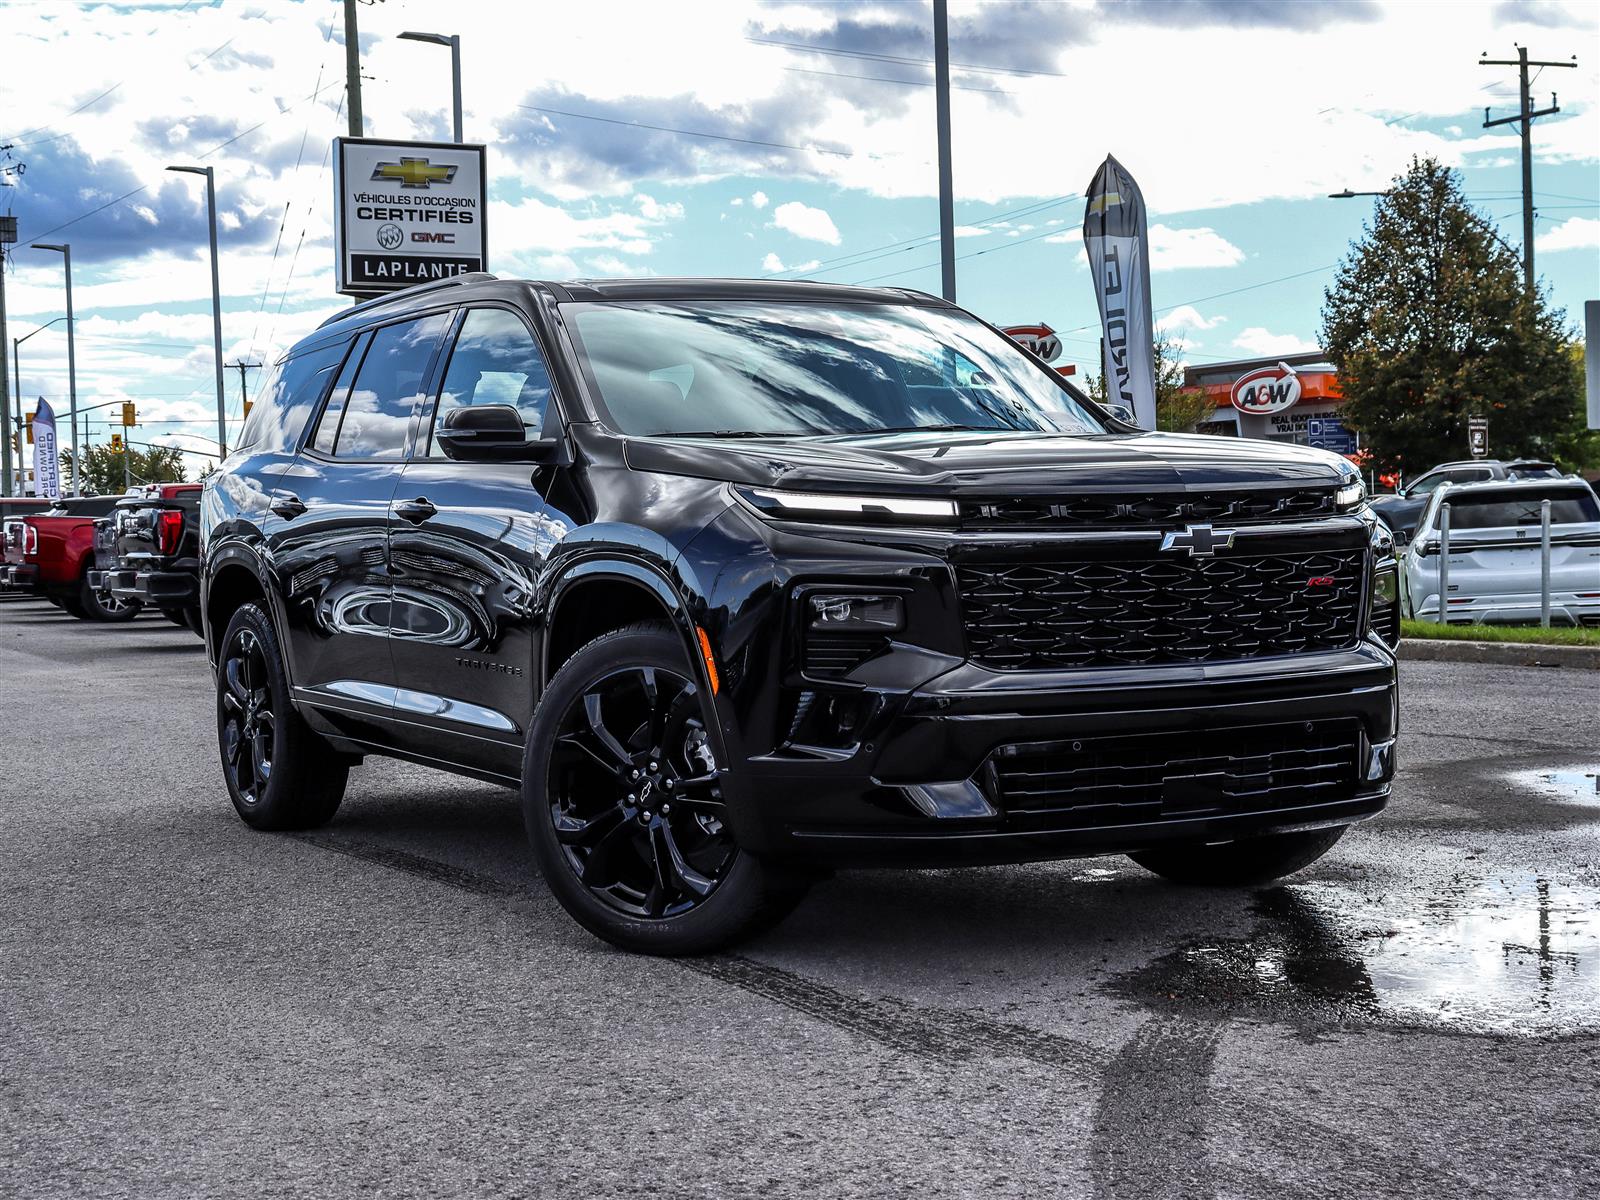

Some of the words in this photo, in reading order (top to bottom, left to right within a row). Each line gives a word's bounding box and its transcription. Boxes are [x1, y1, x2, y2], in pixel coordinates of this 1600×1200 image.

[353, 191, 411, 205] VÉHICULES
[414, 195, 476, 208] D'OCCASION
[356, 206, 474, 224] CERTIFIÉS
[411, 232, 456, 244] GMC
[1241, 383, 1292, 407] A&W
[1271, 416, 1289, 425] REAL
